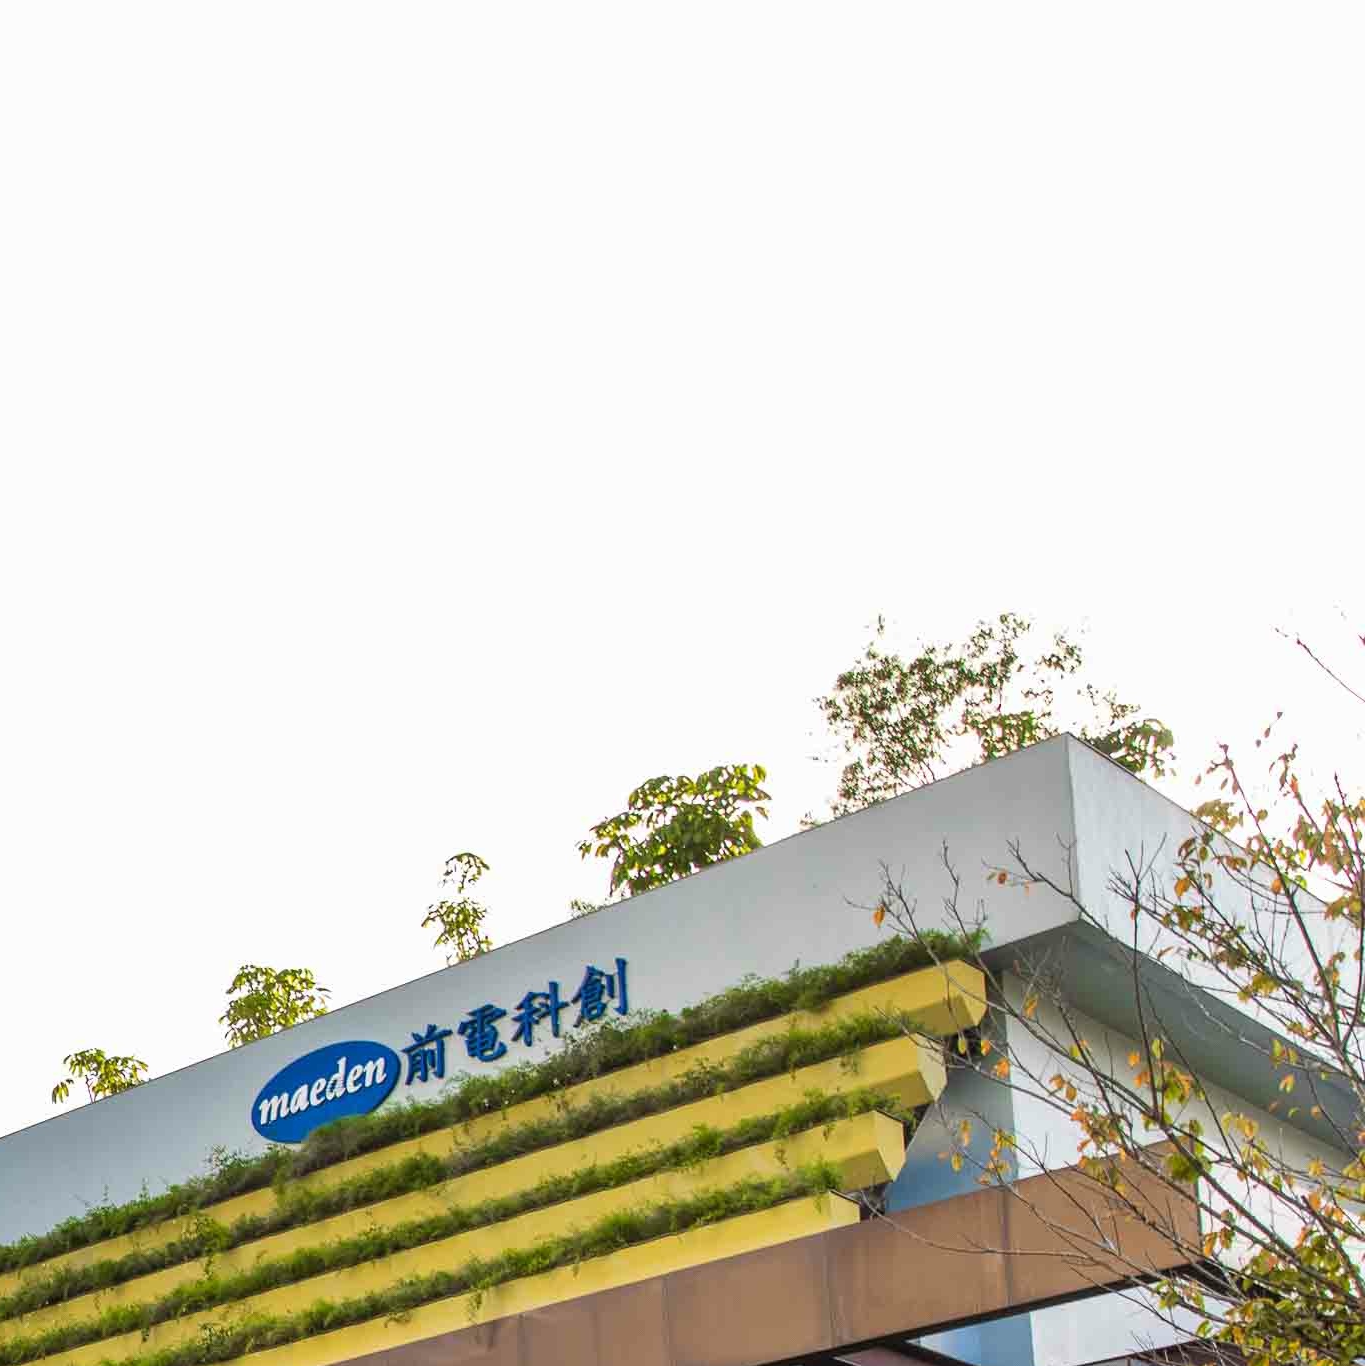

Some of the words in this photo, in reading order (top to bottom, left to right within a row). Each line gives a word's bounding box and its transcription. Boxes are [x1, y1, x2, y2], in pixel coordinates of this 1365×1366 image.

[401, 957, 629, 1085] 前電科創
[259, 1056, 387, 1125] maeden
